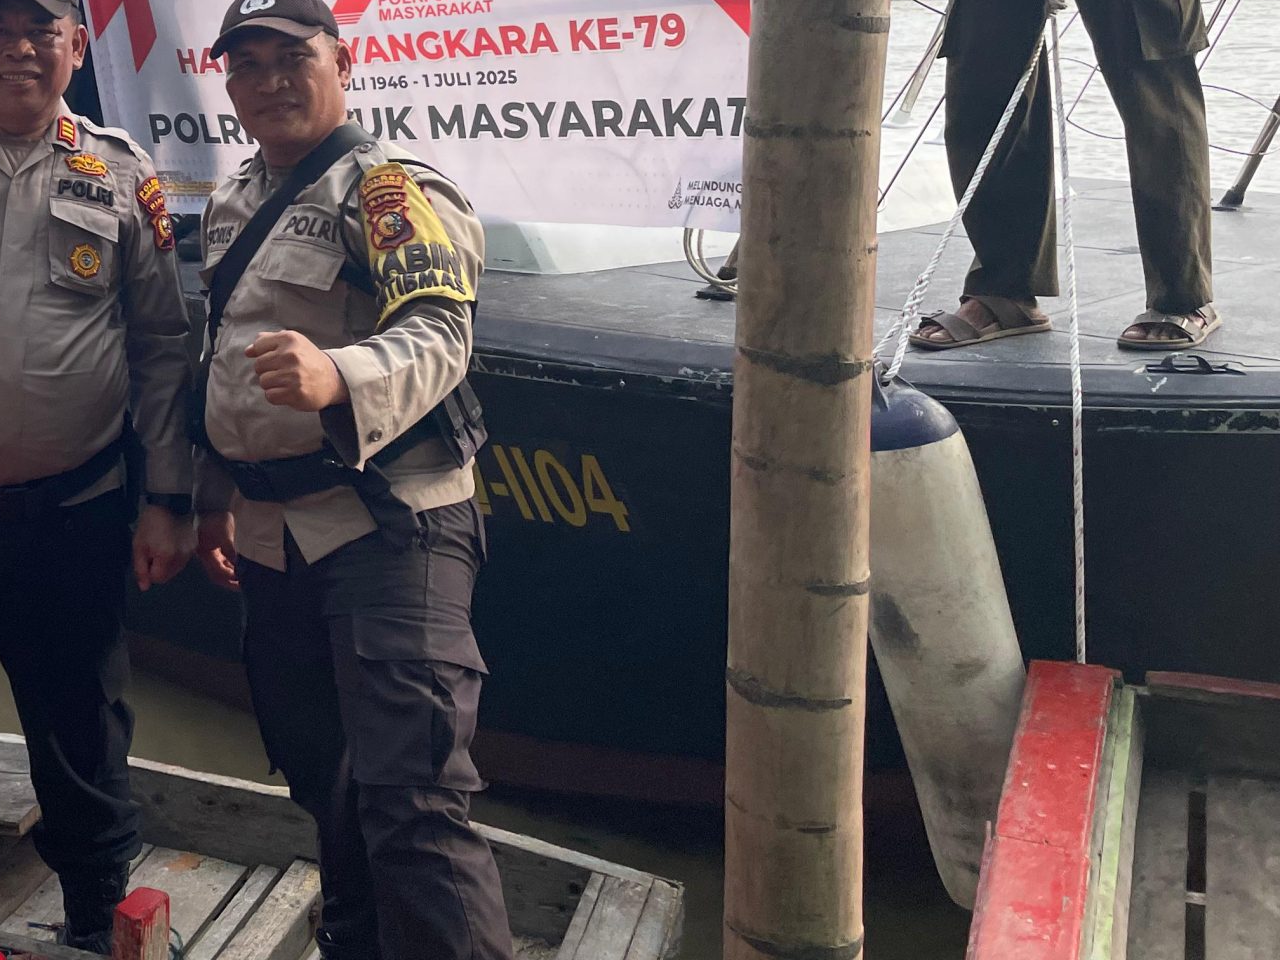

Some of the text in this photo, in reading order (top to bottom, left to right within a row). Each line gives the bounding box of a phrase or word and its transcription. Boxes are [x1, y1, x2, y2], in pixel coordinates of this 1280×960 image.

[378, 0, 493, 22] MASYARAKAT
[176, 12, 686, 74] HA YANGKARA KE-79
[344, 78, 366, 91] ULI
[371, 75, 408, 90] 1946
[422, 74, 430, 87] 1
[434, 72, 471, 87] JULI
[476, 70, 517, 85] 2025
[148, 113, 256, 144] POLR
[427, 97, 748, 140] MASYARAKAT
[58, 179, 113, 207] POLRI
[687, 181, 743, 193] MELINDUNG
[283, 215, 338, 243] POLRI
[373, 243, 463, 283] ABIN
[473, 445, 631, 532] -1104
